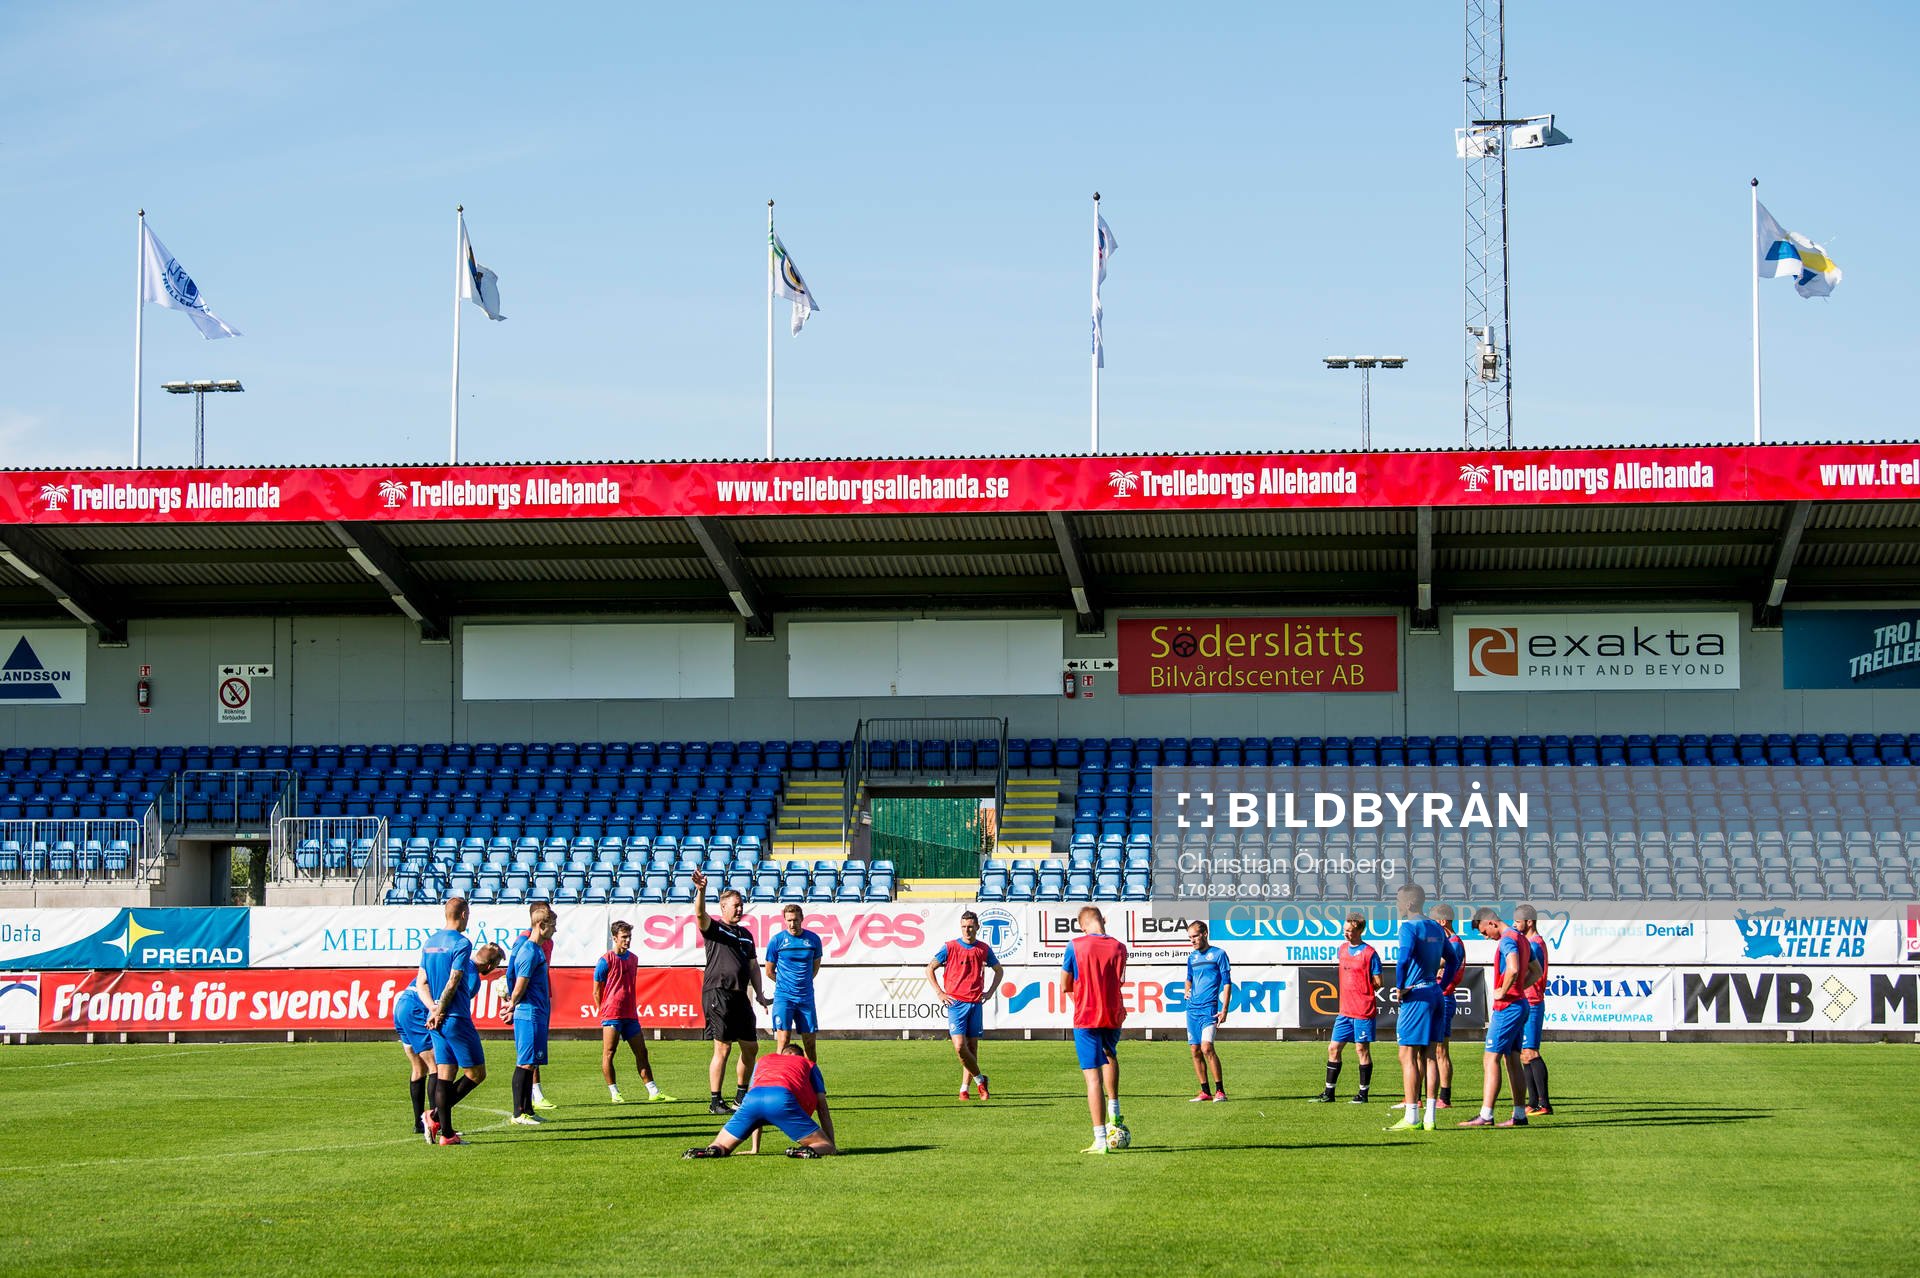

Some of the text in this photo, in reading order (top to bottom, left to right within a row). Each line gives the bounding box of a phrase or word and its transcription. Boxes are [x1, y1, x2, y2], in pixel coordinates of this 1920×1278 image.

[1140, 466, 1357, 500] Trelleborgs Allehanda
[1492, 460, 1714, 495] Trelleborgs Allehanda
[71, 482, 281, 514] Trelleborgs Allehanda
[410, 477, 620, 510] Trelleborgs Allehanda
[716, 473, 1010, 505] www.trelleborgsallehanda.se
[1528, 626, 1725, 657] exakta
[1873, 621, 1911, 649] TRO
[248, 666, 256, 676] K
[1080, 660, 1101, 670] K L
[1151, 663, 1365, 688] Bilvårdscenter AB
[1528, 663, 1725, 676] PRINT AND BEYOND
[0, 671, 71, 682] ANDSSON
[2, 924, 41, 942] Data
[1142, 917, 1189, 933] BCA
[1645, 922, 1694, 937] Dental
[1786, 937, 1866, 958] TELE AB
[52, 980, 184, 1022] Framåt
[190, 981, 248, 1021] för
[249, 979, 371, 1020] svensk
[1577, 1000, 1589, 1010] Vi
[1683, 973, 1815, 1023] MVB
[659, 1004, 698, 1018] SPEL
[1560, 1013, 1568, 1022] &
[1571, 1010, 1653, 1023] VÄRMEPUMPAR
